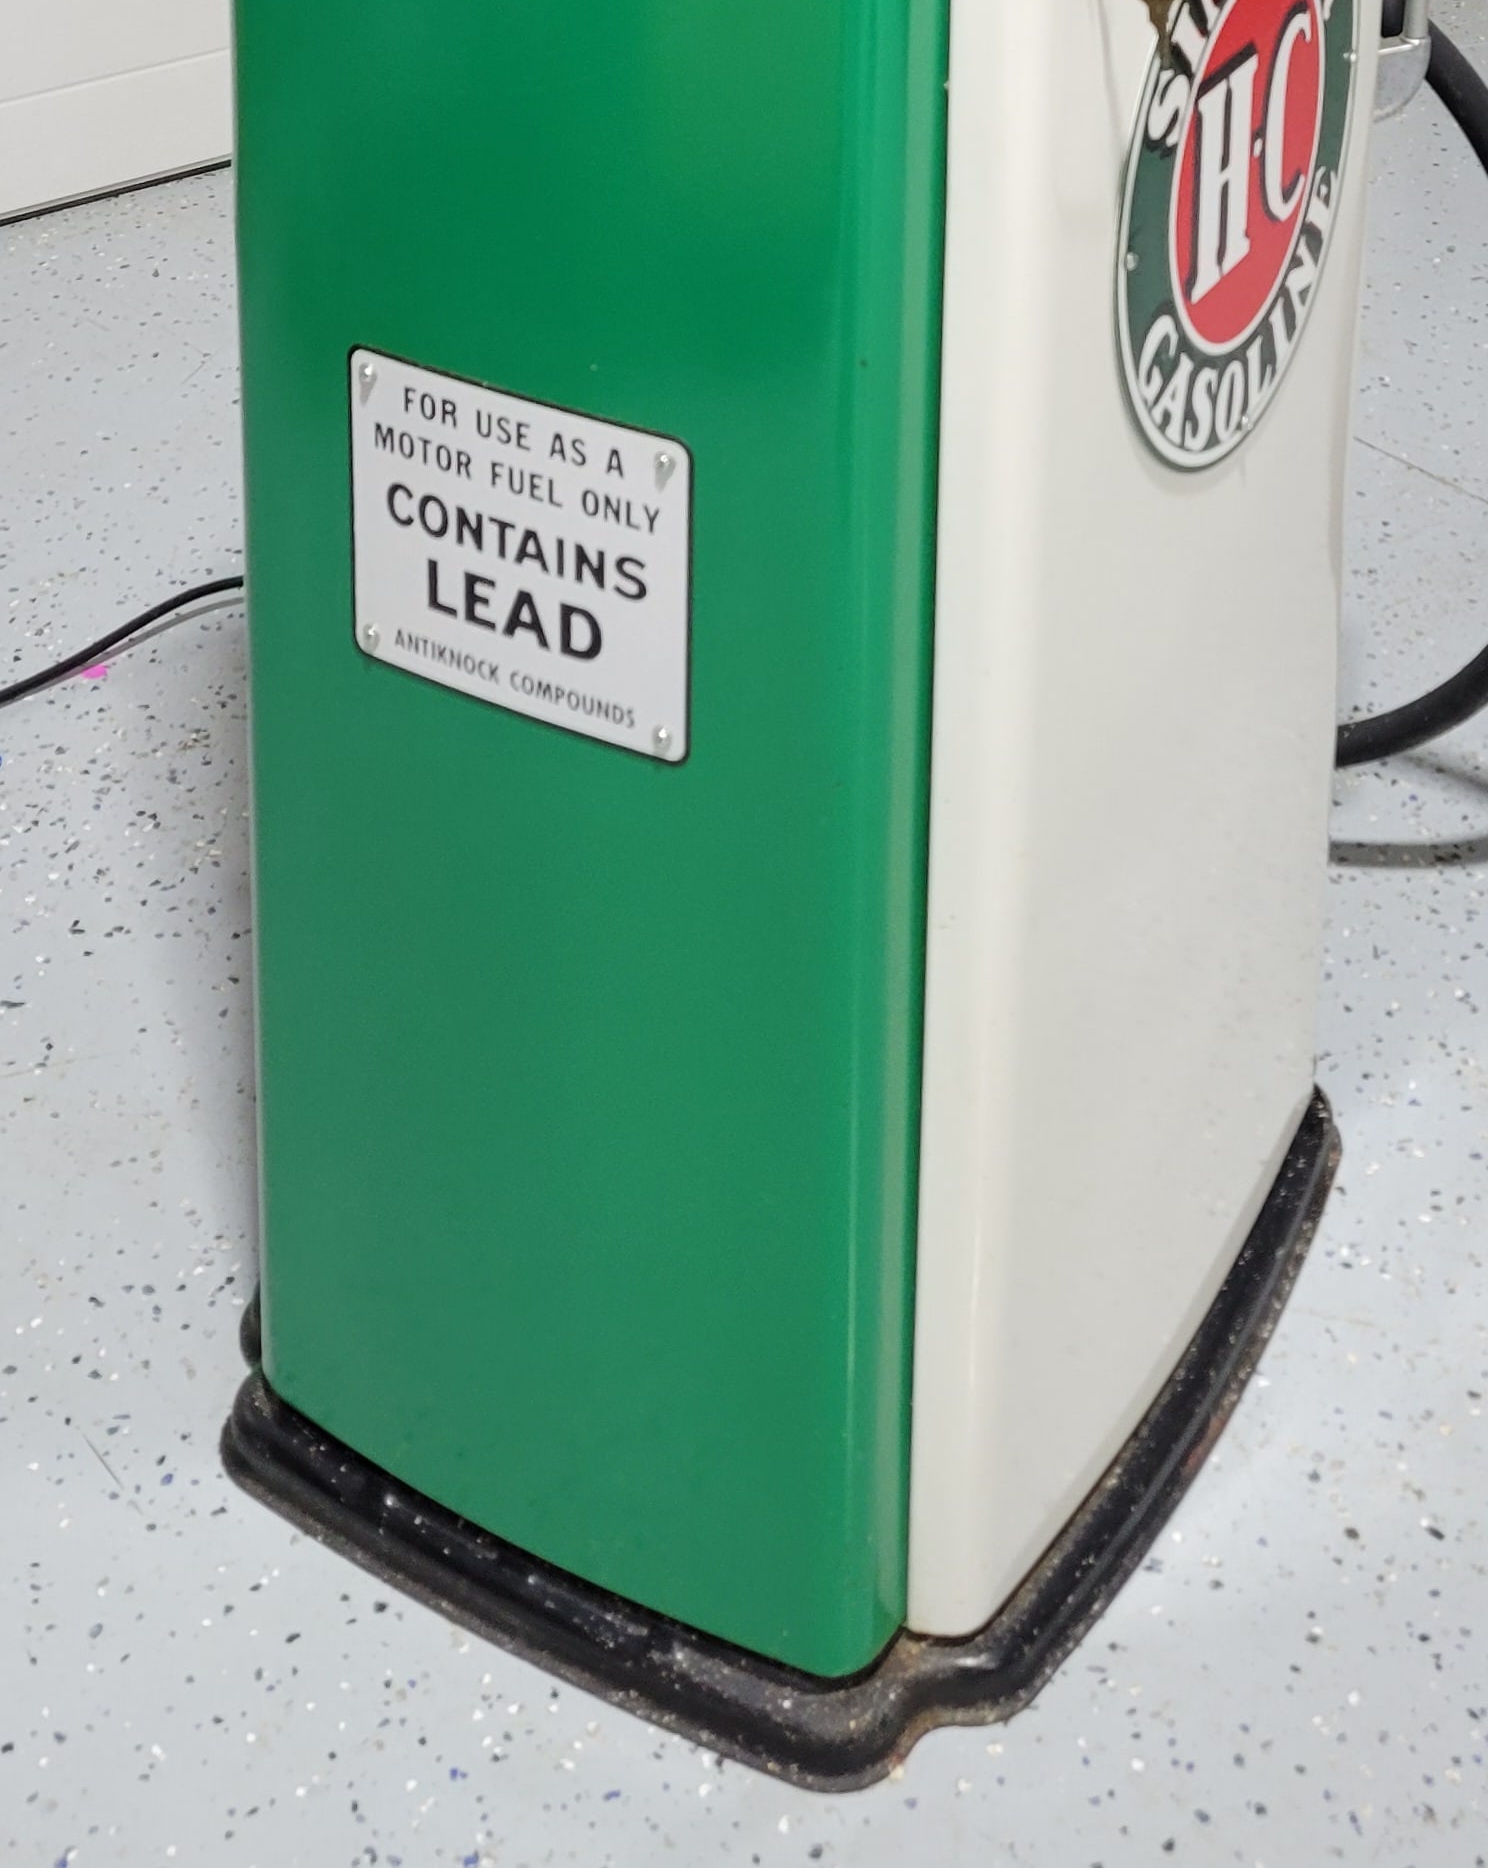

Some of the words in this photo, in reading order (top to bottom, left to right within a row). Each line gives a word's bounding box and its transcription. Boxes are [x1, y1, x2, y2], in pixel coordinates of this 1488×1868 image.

[1137, 170, 1336, 454] GASOLINE
[373, 422, 473, 480] MOTOR
[490, 461, 563, 509] FUEL
[581, 490, 660, 534] ONLY
[403, 387, 458, 429] FOR
[475, 409, 532, 451] USE
[549, 432, 588, 468] AS
[606, 448, 625, 479] A
[386, 482, 648, 601] CONTAINS
[427, 558, 603, 661] LEAD
[394, 629, 500, 684] ANTIKNOCK
[509, 670, 636, 730] COMPOUNDS
